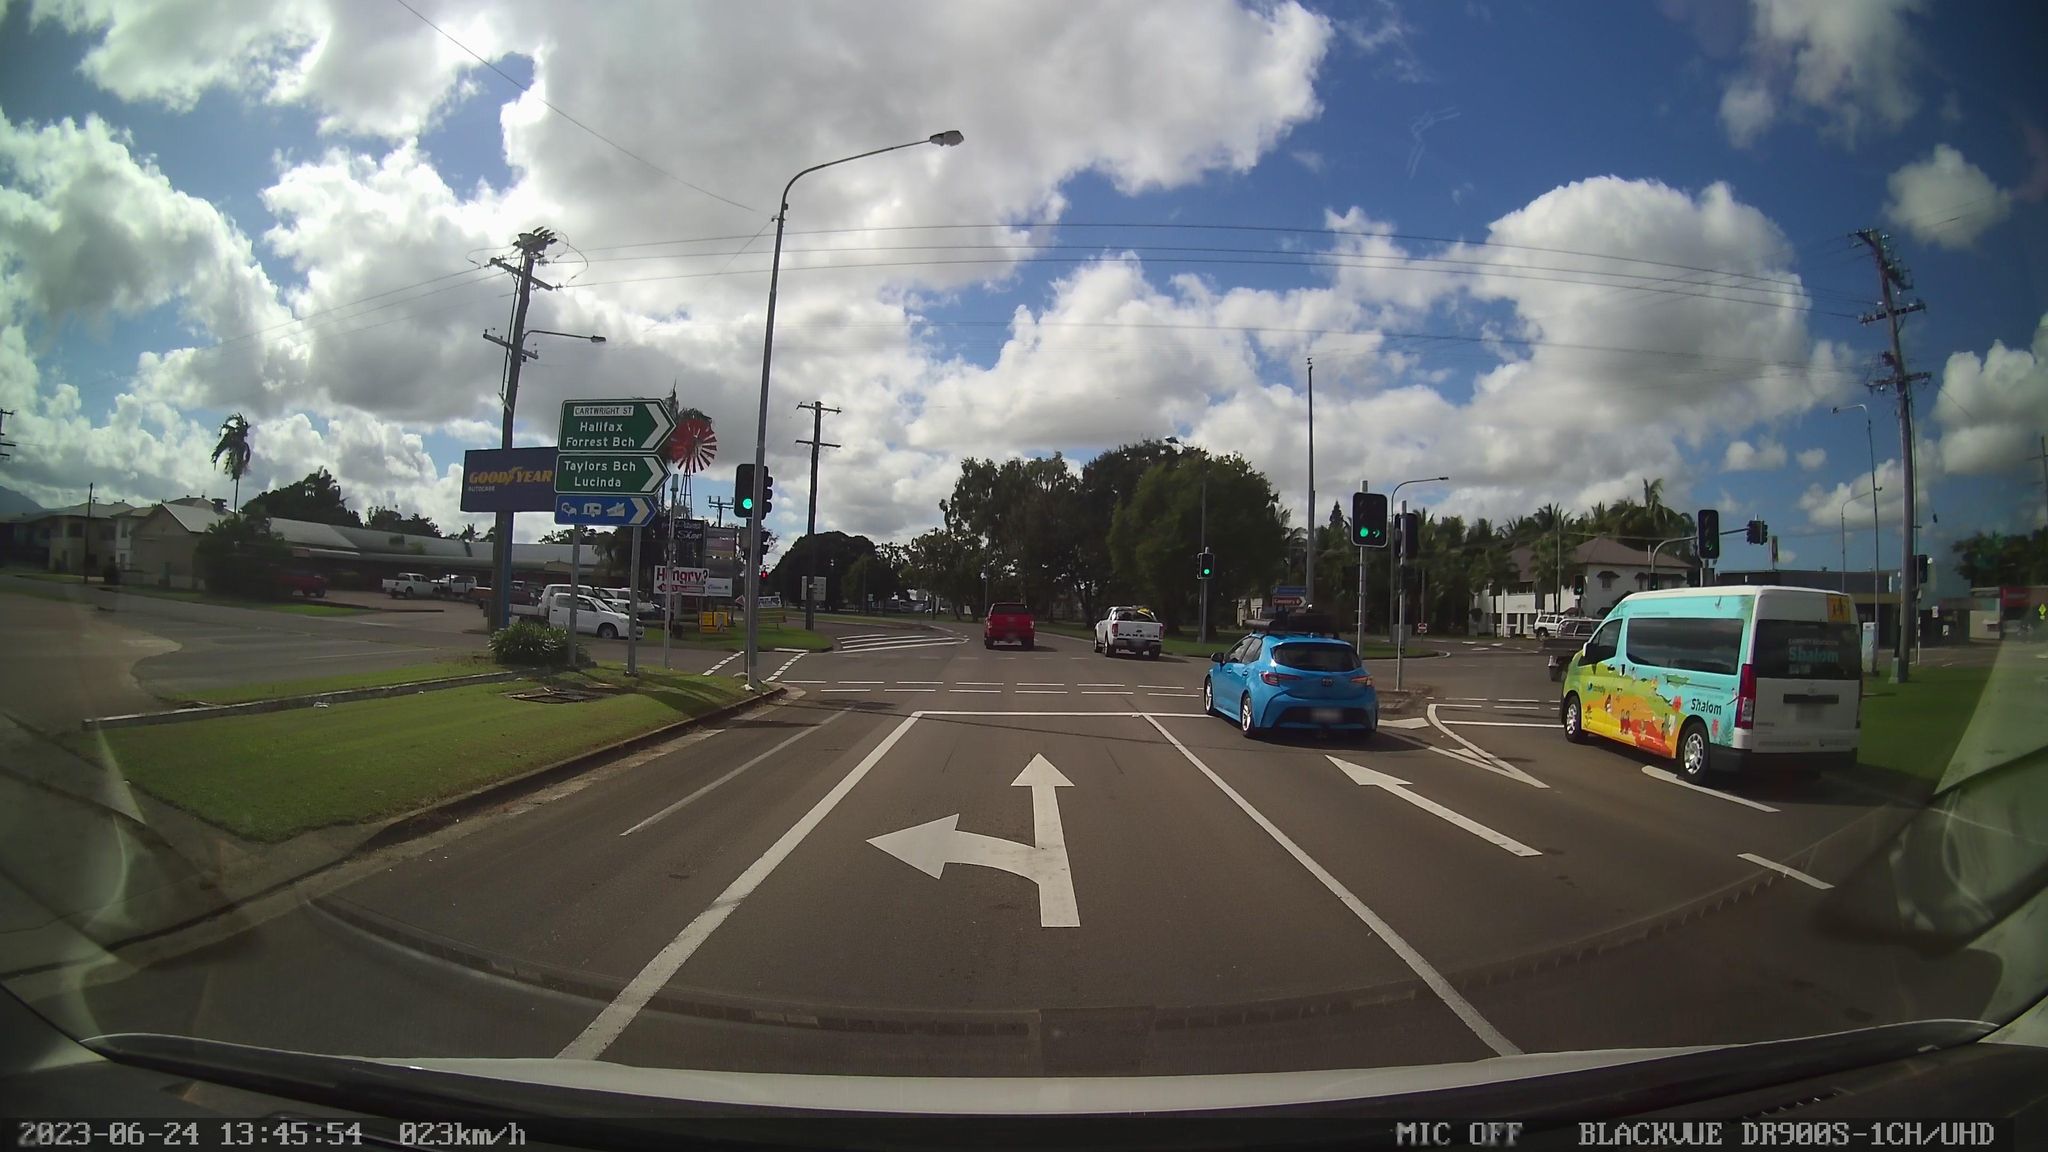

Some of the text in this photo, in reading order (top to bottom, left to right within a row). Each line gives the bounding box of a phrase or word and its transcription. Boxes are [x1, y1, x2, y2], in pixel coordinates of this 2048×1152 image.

[575, 407, 619, 415] CARTWRIGHT
[580, 422, 623, 432] Halifax
[566, 437, 635, 447] Forrest Bch
[564, 460, 636, 473] Taylors Bch
[469, 468, 553, 485] GOODYEAR
[575, 477, 621, 487] Lucinda
[657, 567, 709, 585] Hngry?
[1788, 646, 1840, 664] Shalom
[1690, 698, 1722, 715] Shalom
